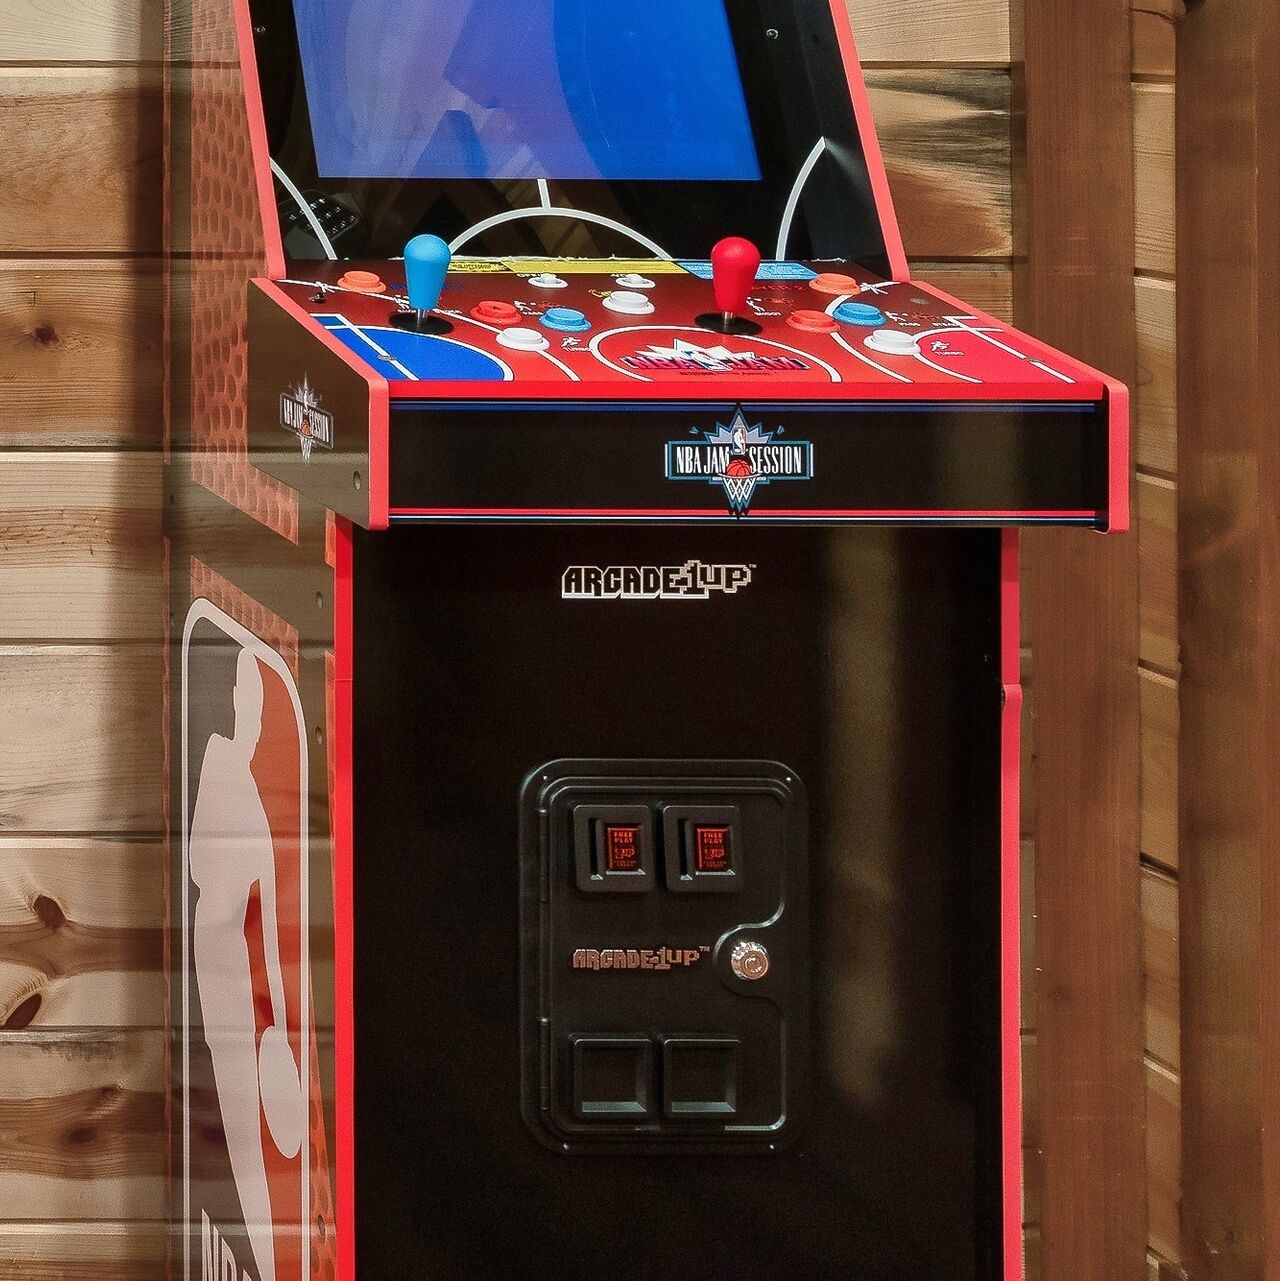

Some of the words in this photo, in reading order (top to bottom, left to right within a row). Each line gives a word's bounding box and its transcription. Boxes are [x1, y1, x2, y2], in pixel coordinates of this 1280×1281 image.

[676, 446, 702, 474] NBA
[703, 446, 730, 474] JAM
[748, 446, 802, 474] SESSION
